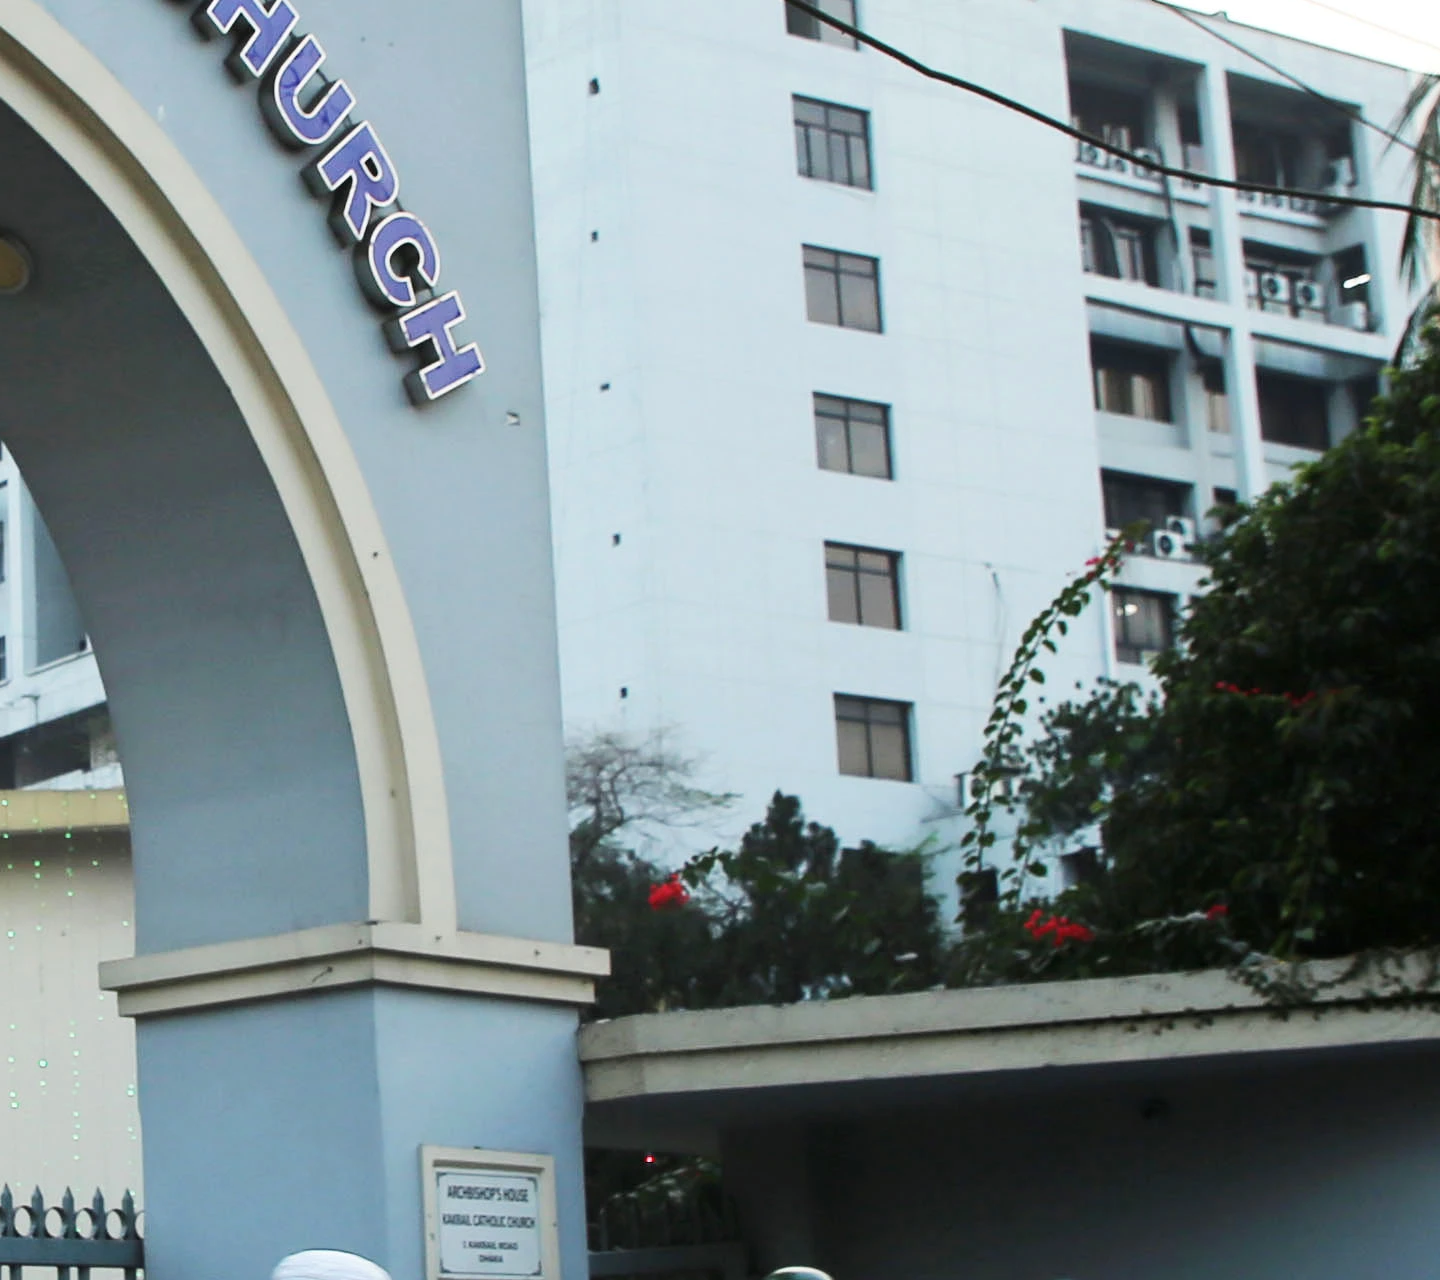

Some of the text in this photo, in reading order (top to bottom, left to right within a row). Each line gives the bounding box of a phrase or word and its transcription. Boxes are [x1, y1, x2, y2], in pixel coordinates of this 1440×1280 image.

[448, 1185, 528, 1202] ARCHBISHOP'S HOUSE
[442, 1214, 535, 1228] KAKRAIL CATHOLIC CHURCH
[498, 1242, 518, 1250] ROAD
[479, 1254, 503, 1263] DHAKA
